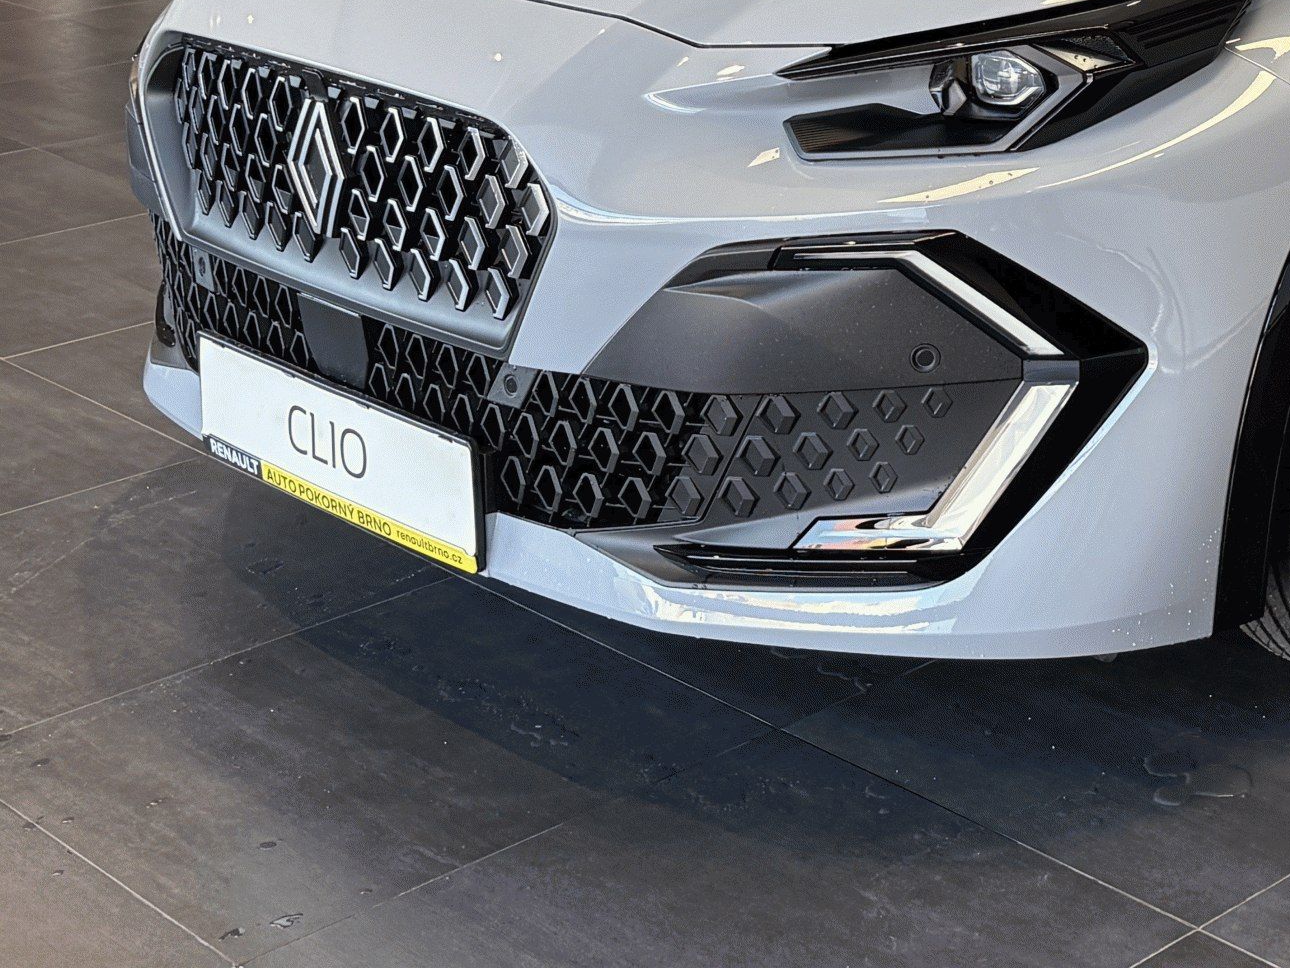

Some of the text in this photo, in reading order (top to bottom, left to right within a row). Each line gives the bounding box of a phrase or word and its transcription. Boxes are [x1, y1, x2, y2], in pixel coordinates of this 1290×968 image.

[288, 405, 367, 479] CLIO
[210, 438, 463, 565] RENAULT AUTO POKORNÝ BRNO renaultbrno.cz
